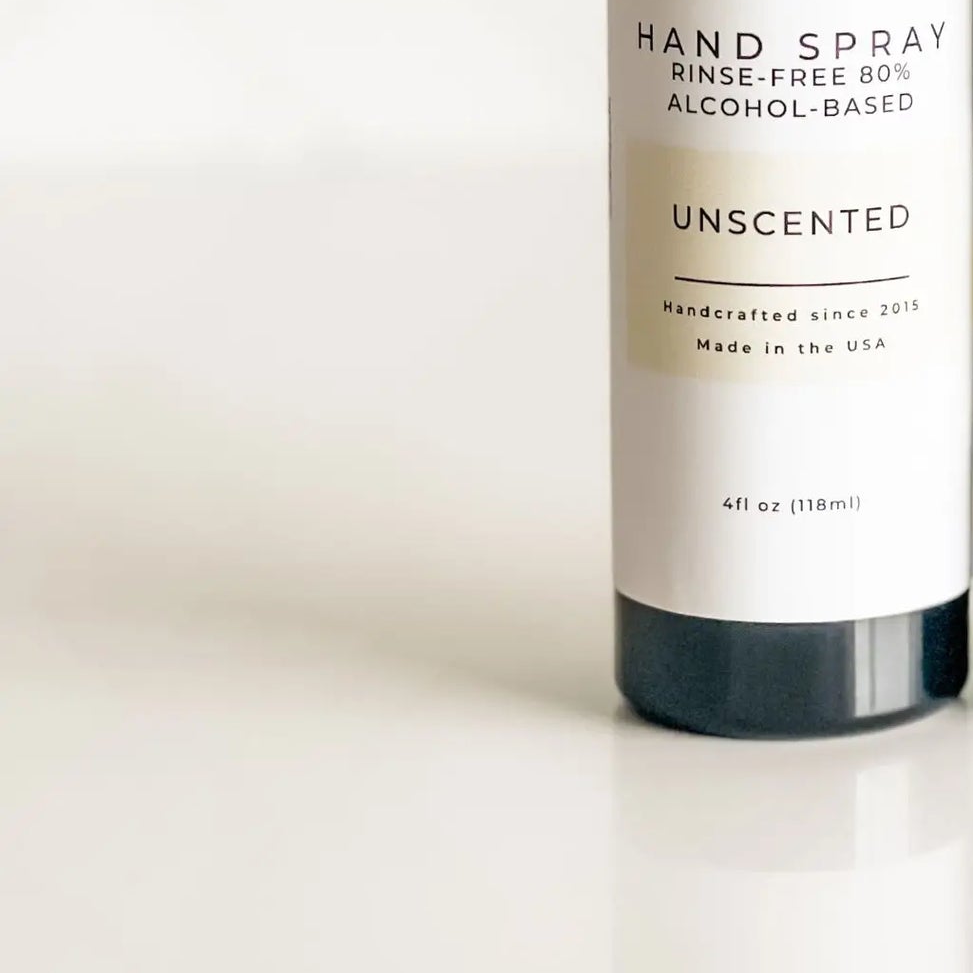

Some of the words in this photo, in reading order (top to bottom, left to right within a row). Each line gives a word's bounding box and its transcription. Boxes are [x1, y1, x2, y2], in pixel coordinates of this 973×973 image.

[638, 21, 764, 61] HAND
[799, 21, 946, 61] SPRAY
[672, 62, 847, 87] RINSE-FREE
[860, 62, 911, 84] 80%
[667, 92, 914, 118] ALCOHOL-BASED
[673, 203, 910, 236] UNSCENTED
[664, 300, 798, 322] Handcrafted
[811, 308, 869, 322] since
[880, 300, 920, 317] 2015
[697, 338, 752, 354] Made
[765, 342, 785, 355] in
[798, 342, 834, 355] the
[847, 337, 886, 352] USA
[722, 496, 749, 511] 4fl
[758, 500, 781, 512] oz
[790, 496, 861, 515] (118ml)
